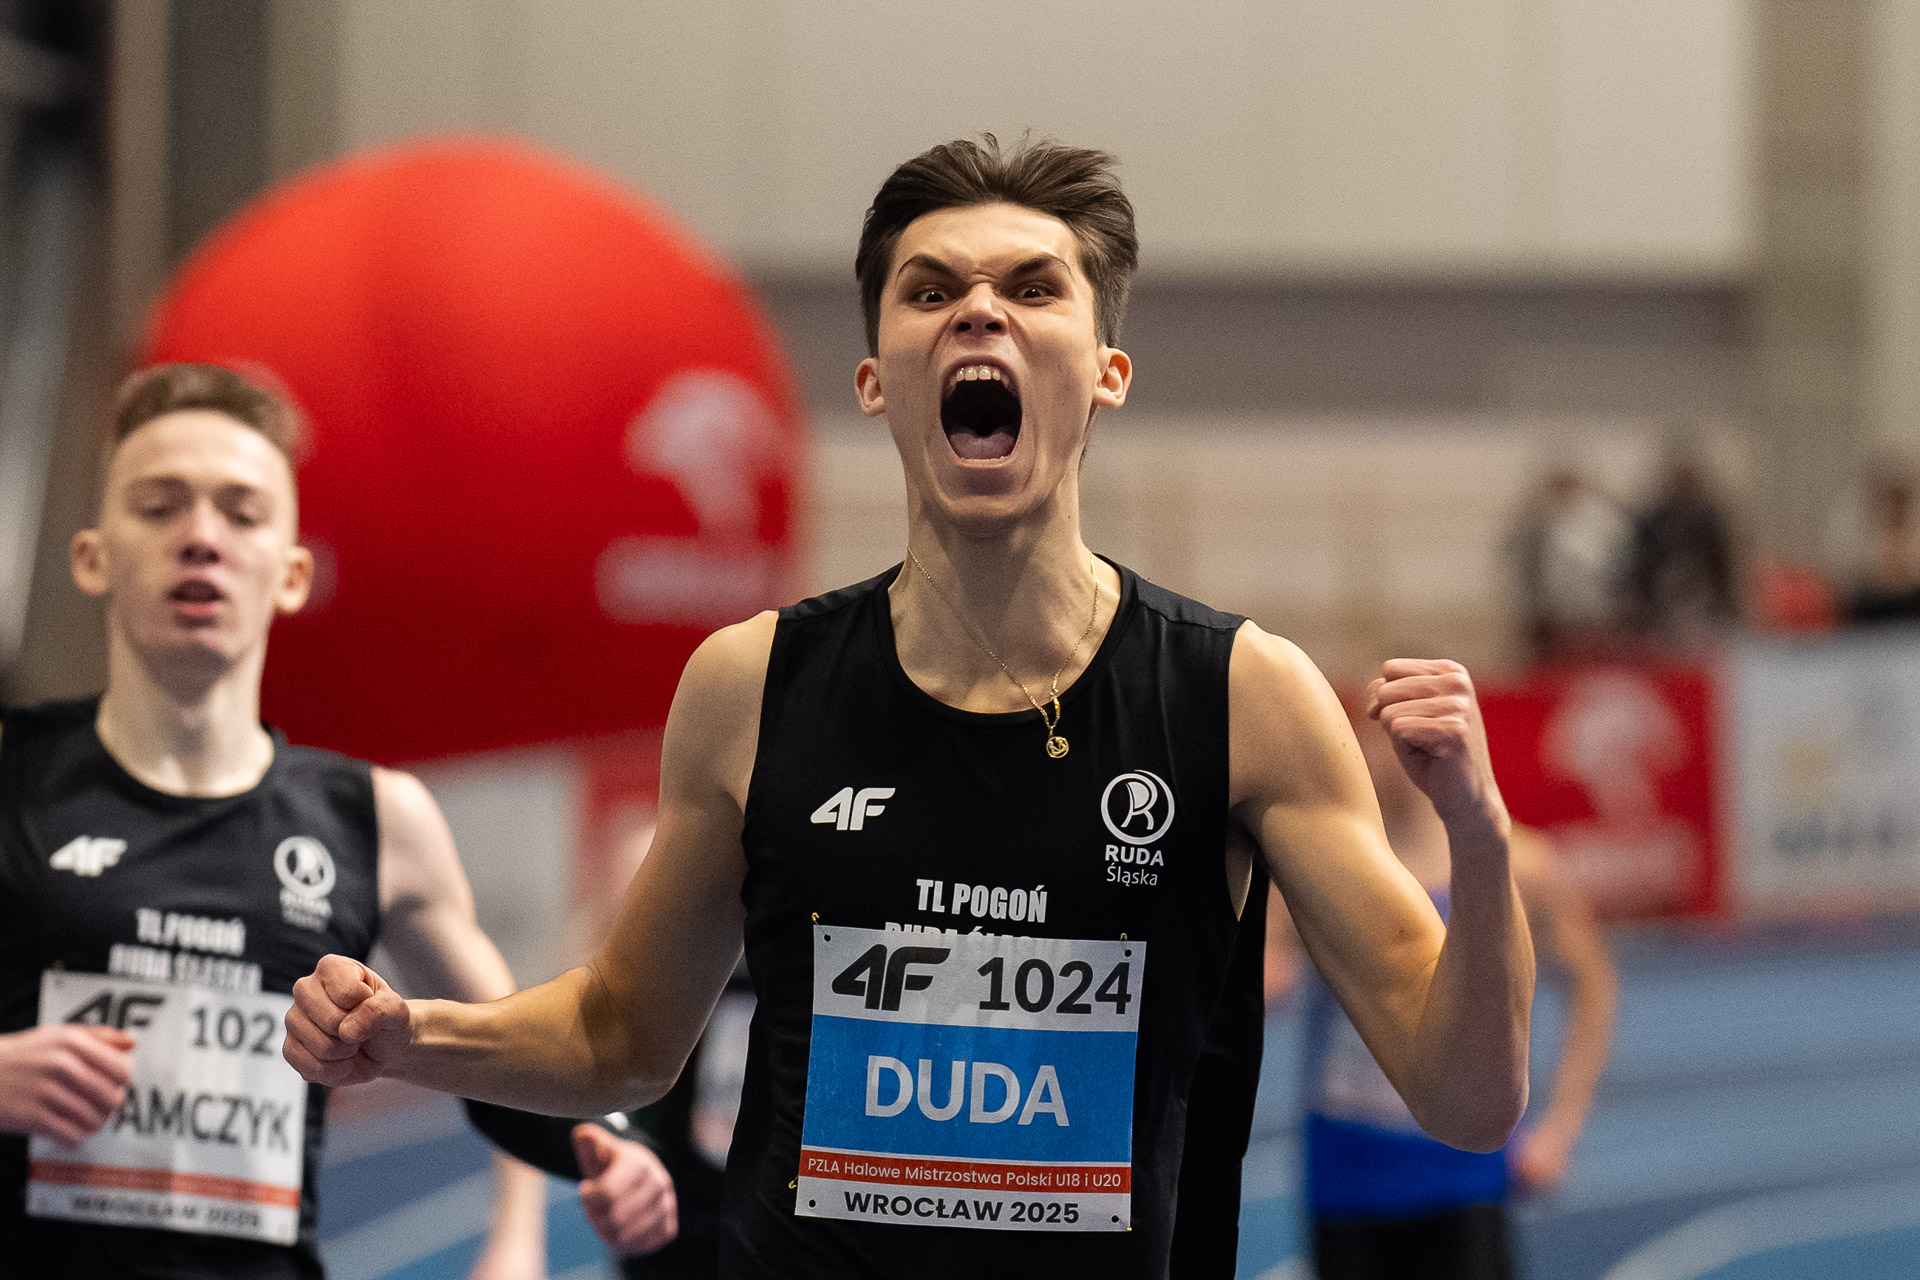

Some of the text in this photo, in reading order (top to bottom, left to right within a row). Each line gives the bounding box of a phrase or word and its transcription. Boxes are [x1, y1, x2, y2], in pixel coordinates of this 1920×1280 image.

[810, 786, 896, 831] 4F
[1105, 844, 1164, 867] RUDA
[1106, 862, 1158, 887] Śląska
[917, 878, 1048, 923] TL POGOŃ
[831, 943, 951, 1012] 4F
[976, 956, 1132, 1015] 1024
[865, 1055, 1070, 1127] DUDA
[808, 1157, 1121, 1188] PZLA Halowe Mistrzostwa Polski U18 i U20
[844, 1191, 1079, 1224] WROCŁAW 2025
